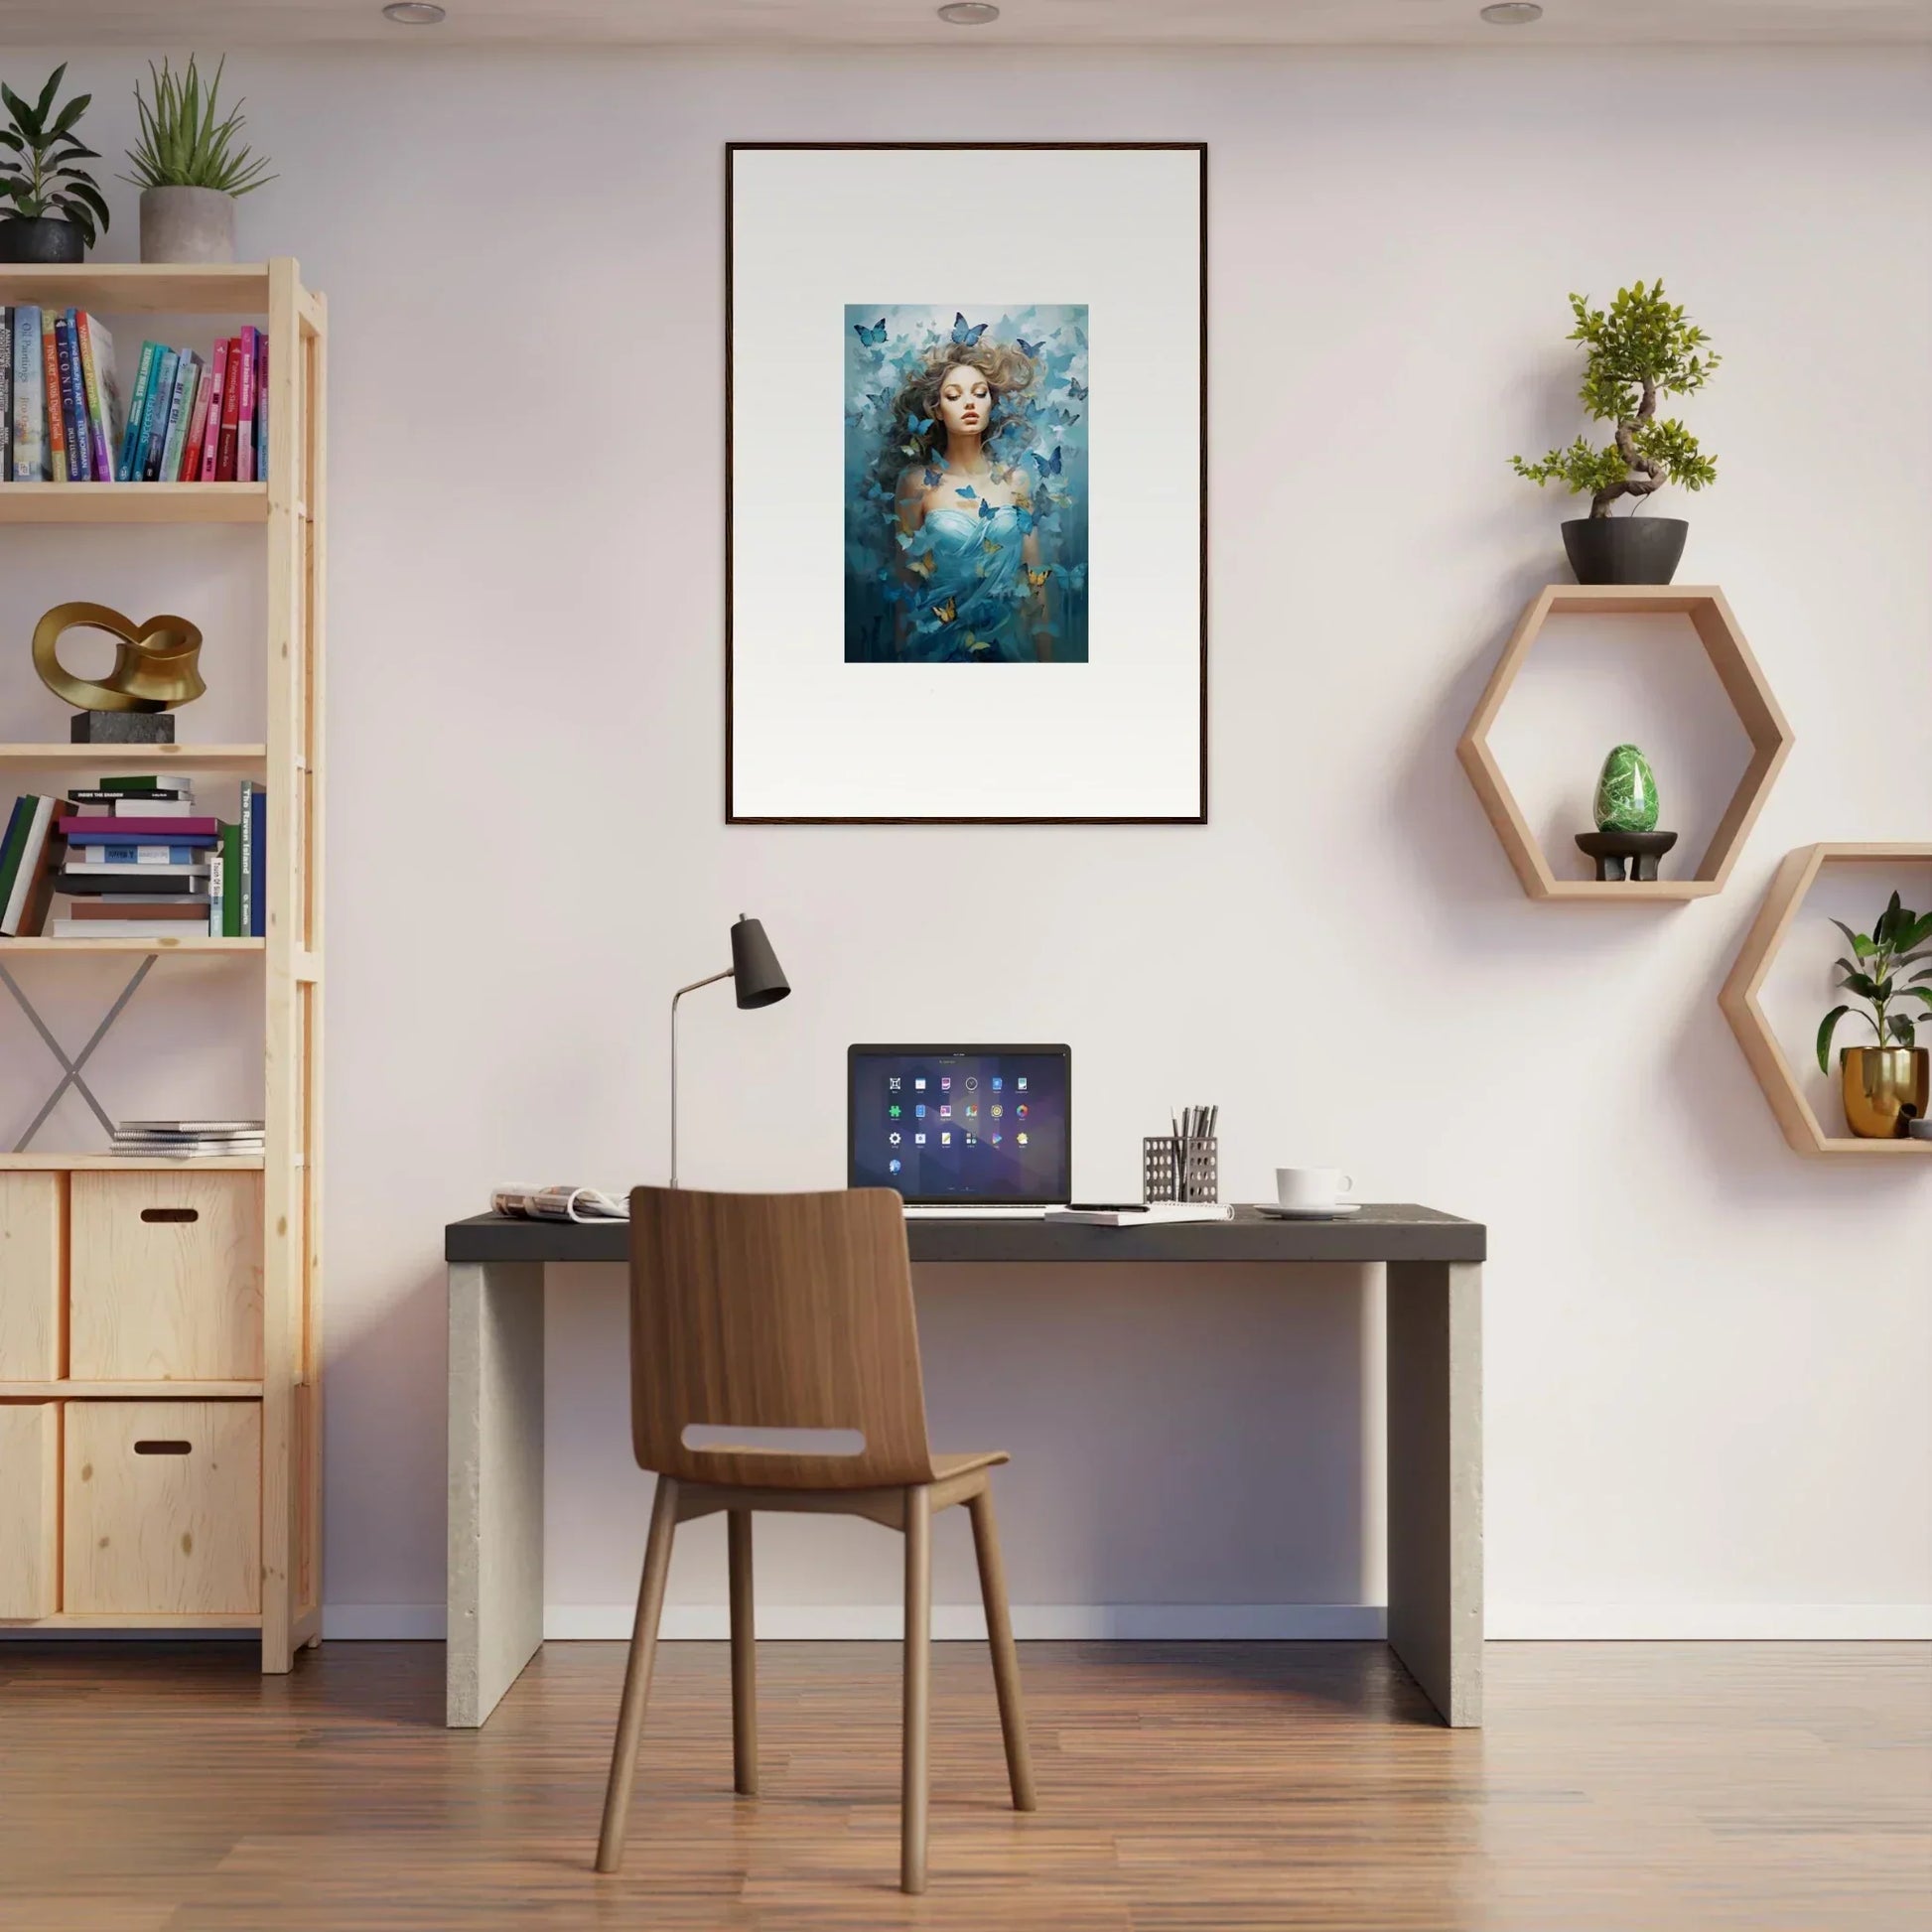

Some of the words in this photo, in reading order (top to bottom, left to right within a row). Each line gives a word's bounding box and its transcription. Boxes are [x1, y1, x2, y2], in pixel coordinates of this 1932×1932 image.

[22, 323, 33, 338] Oil
[18, 340, 33, 383] Paintings
[79, 325, 91, 370] Watercolor
[85, 372, 97, 408] Portraits
[228, 360, 239, 394] Parenting
[49, 399, 60, 421] Digital
[226, 394, 237, 412] Skills
